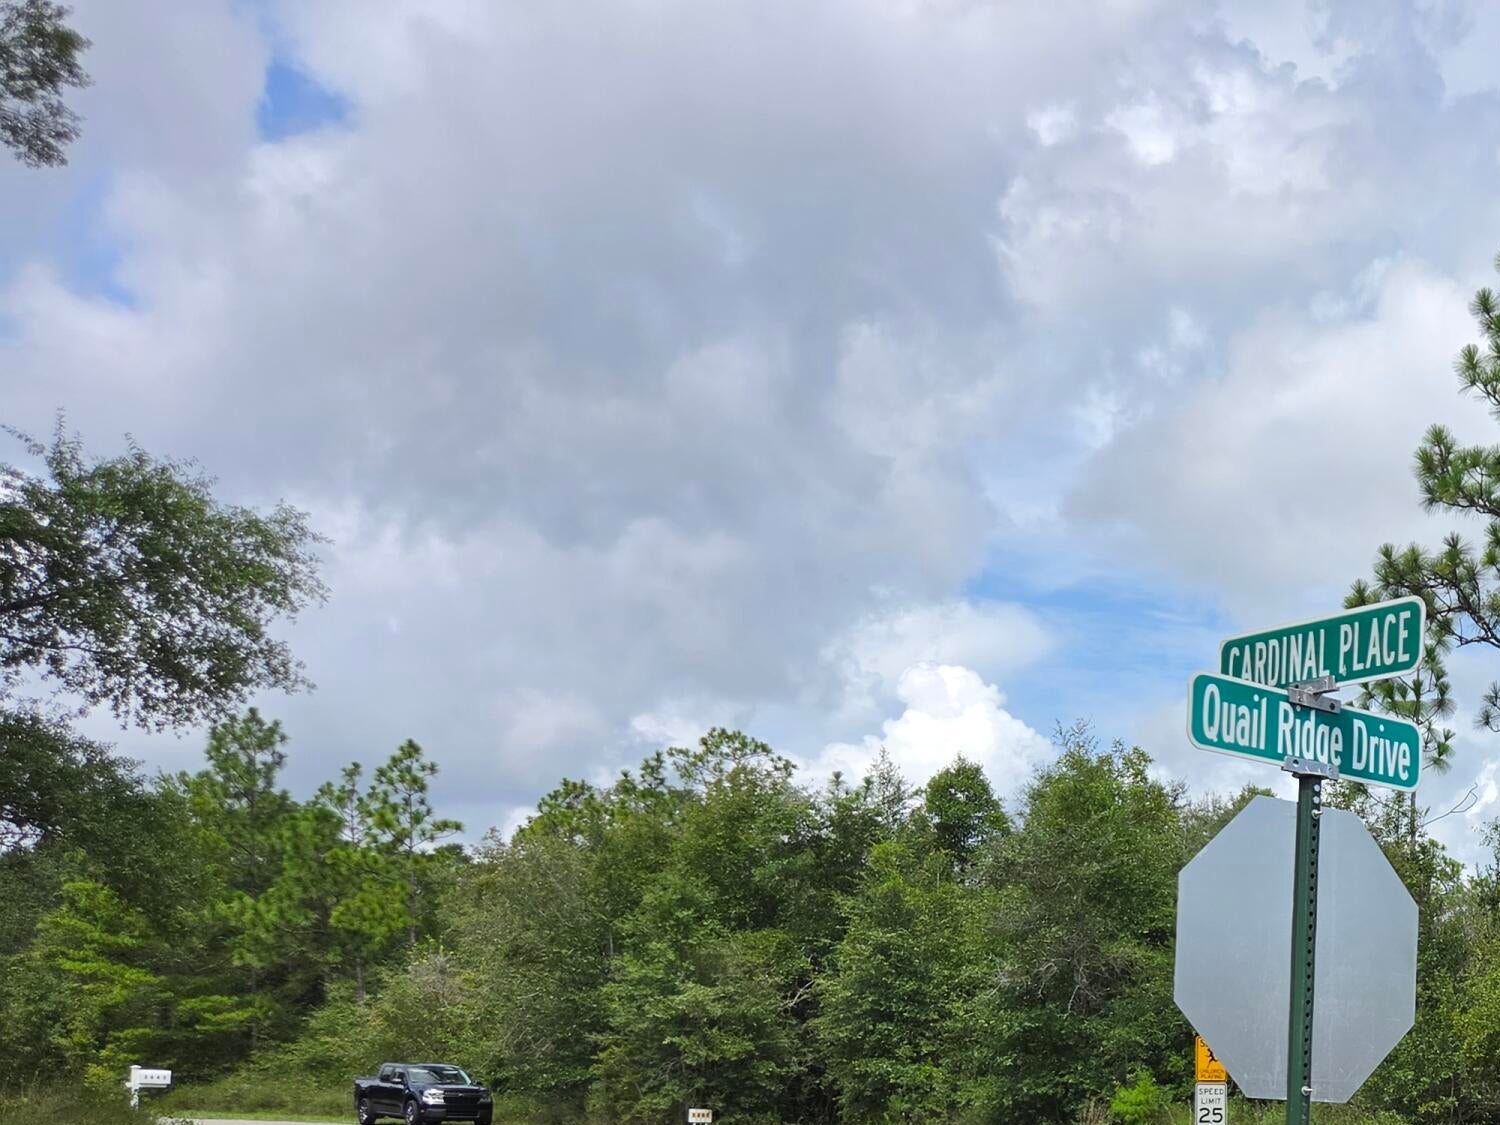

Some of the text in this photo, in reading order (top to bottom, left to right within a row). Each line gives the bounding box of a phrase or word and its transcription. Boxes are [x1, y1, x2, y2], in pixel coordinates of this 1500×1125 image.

[1229, 610, 1411, 687] CARDINAL PLACE
[1202, 683, 1411, 780] Quail Ridge Drive
[1199, 1107, 1223, 1123] 25
